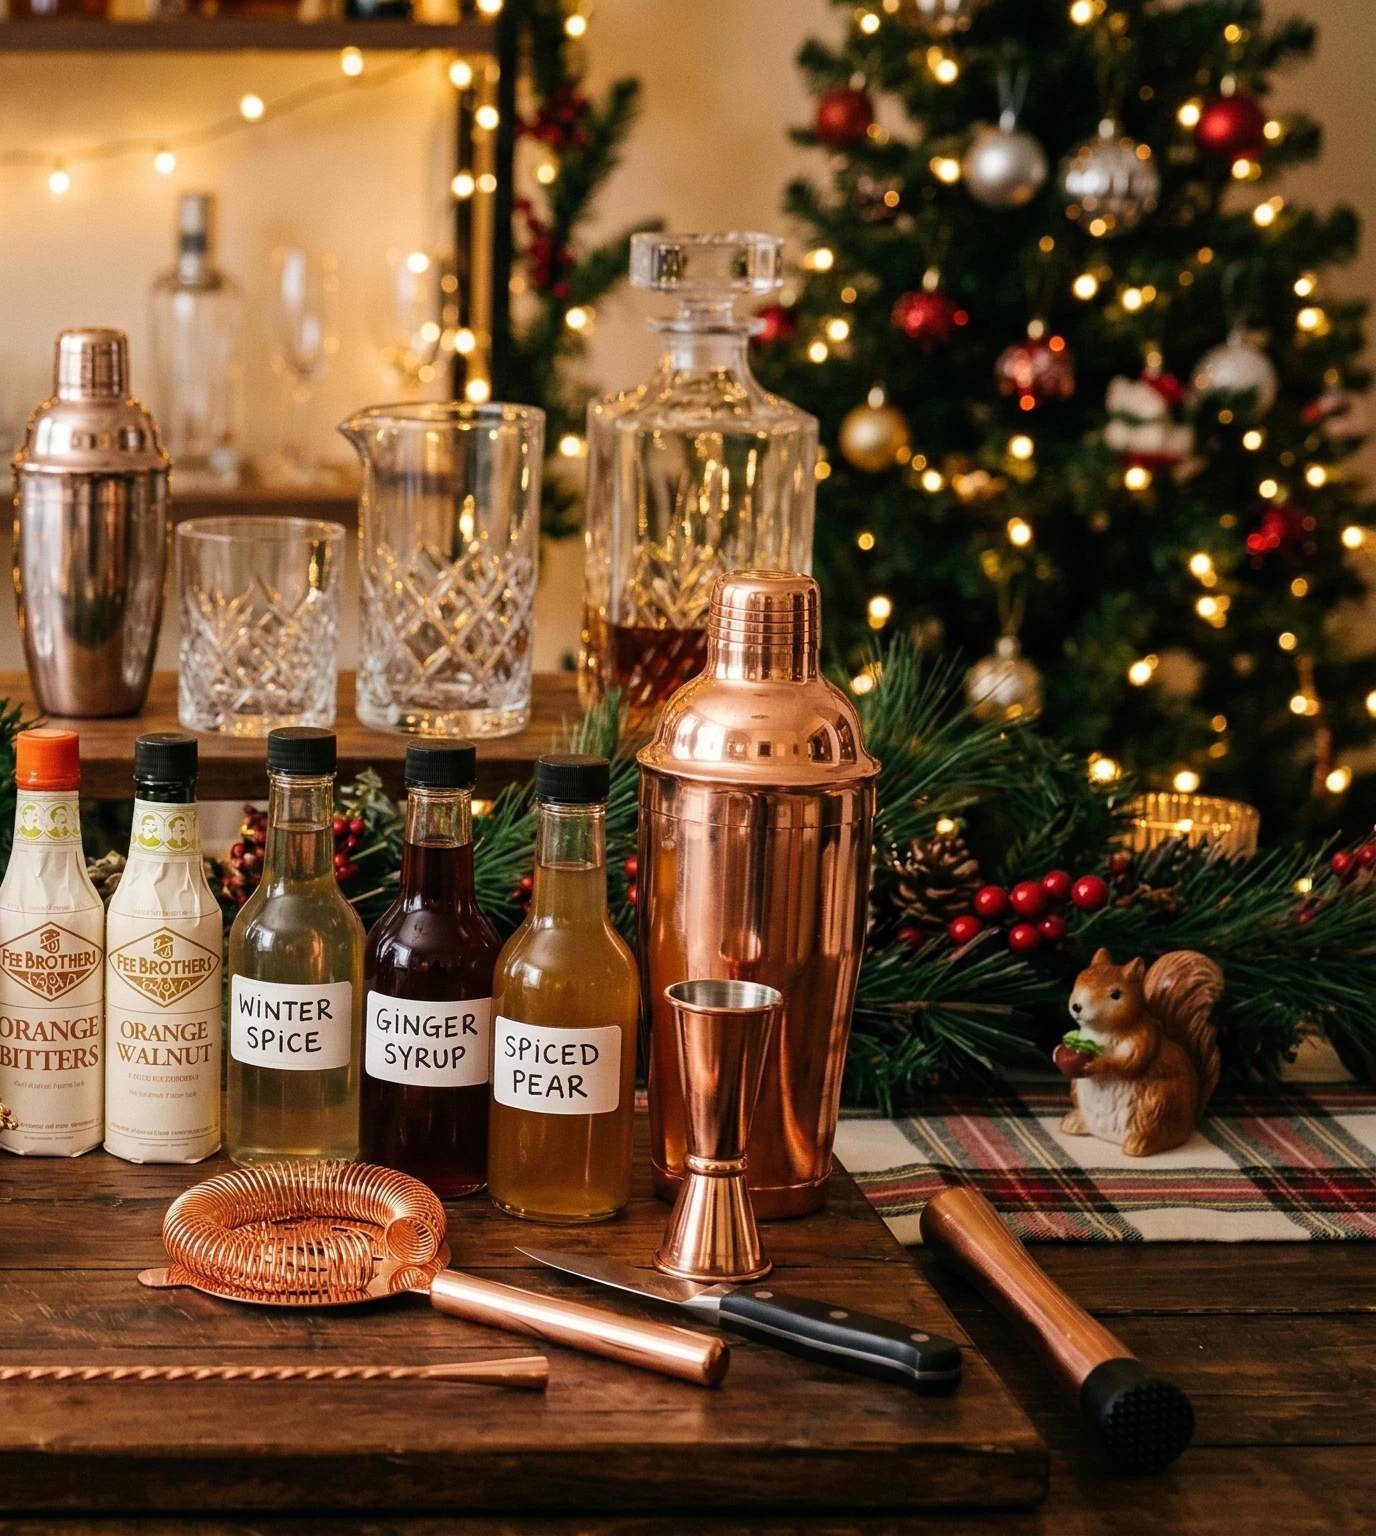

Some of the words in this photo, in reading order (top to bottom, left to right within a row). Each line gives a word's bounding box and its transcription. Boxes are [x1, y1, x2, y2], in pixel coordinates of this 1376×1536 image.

[2, 948, 23, 968] FEE
[117, 953, 136, 973] FEE
[139, 955, 212, 975] BROTHERS
[120, 1020, 209, 1042] ORANGE
[0, 1044, 99, 1071] BITTERS
[116, 1042, 213, 1066] WALNUT
[384, 1043, 466, 1071] SYRUP
[513, 1069, 588, 1099] PEAR
